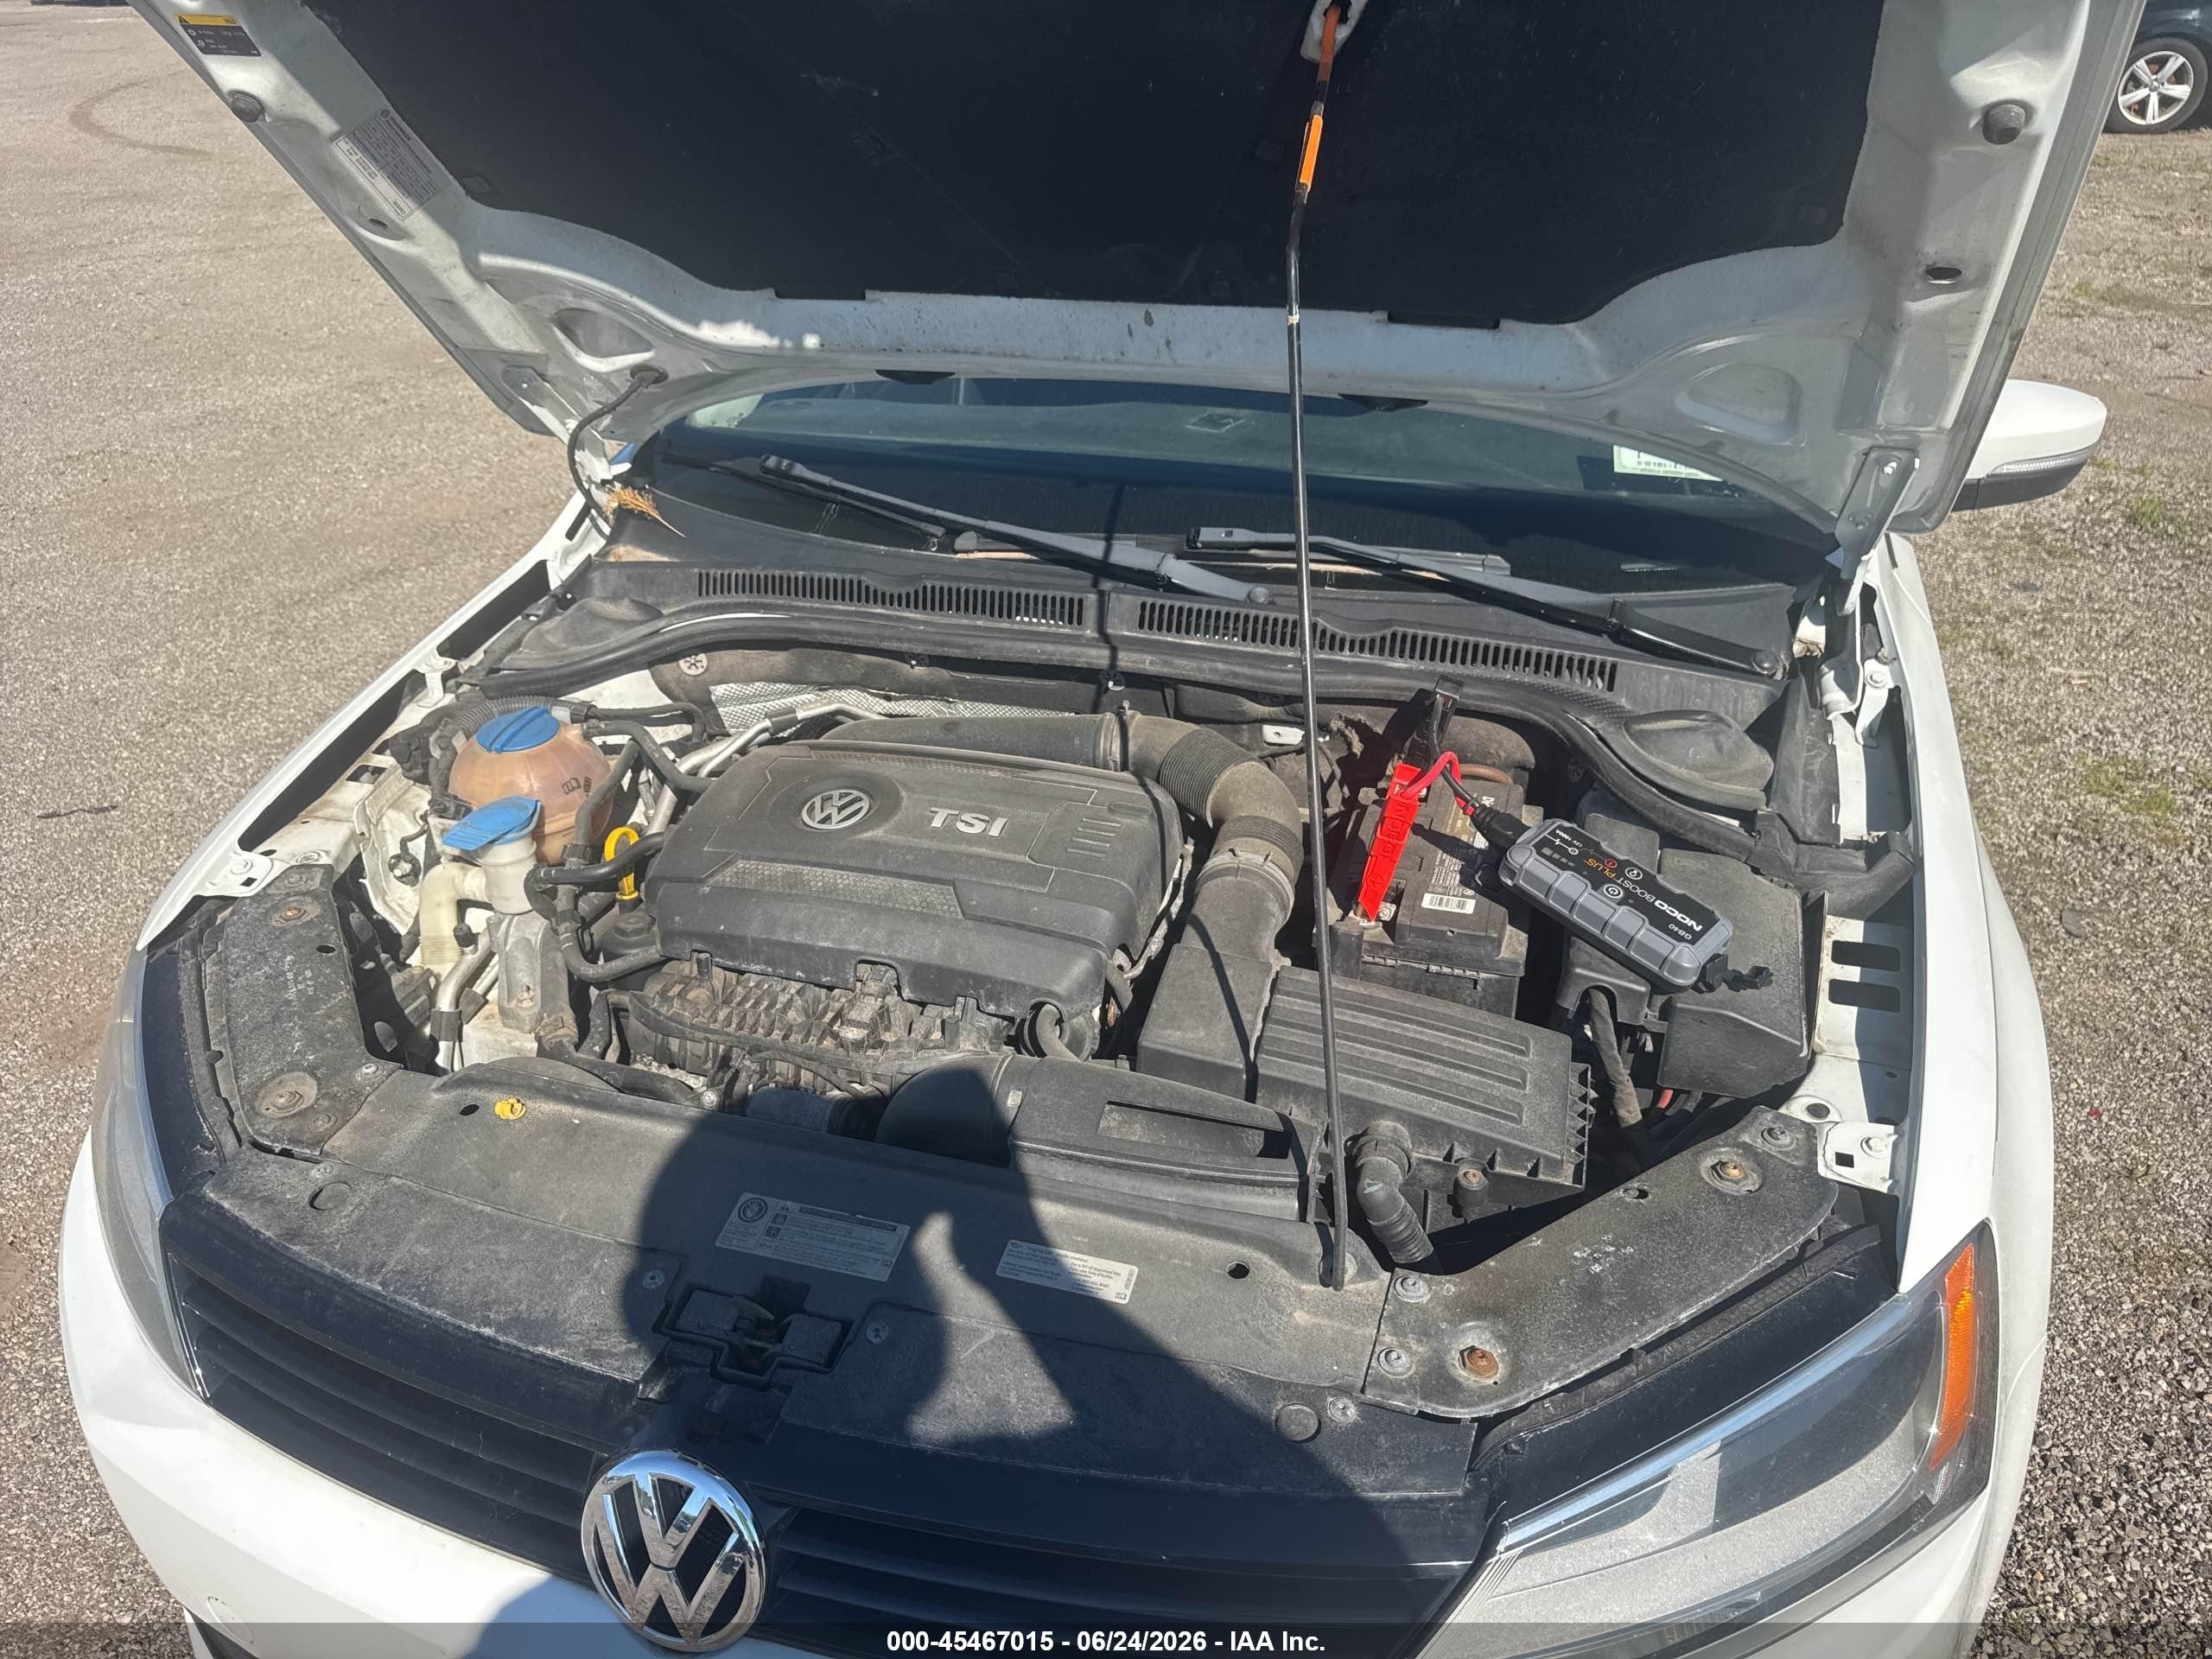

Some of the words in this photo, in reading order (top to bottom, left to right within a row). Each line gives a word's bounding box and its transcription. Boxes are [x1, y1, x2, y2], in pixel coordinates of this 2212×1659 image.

[930, 807, 1008, 837] TSI
[1586, 858, 1618, 879] PLUS
[1617, 877, 1656, 903] BOOST
[1654, 899, 1703, 932] NOCO
[1669, 924, 1692, 940] GB40
